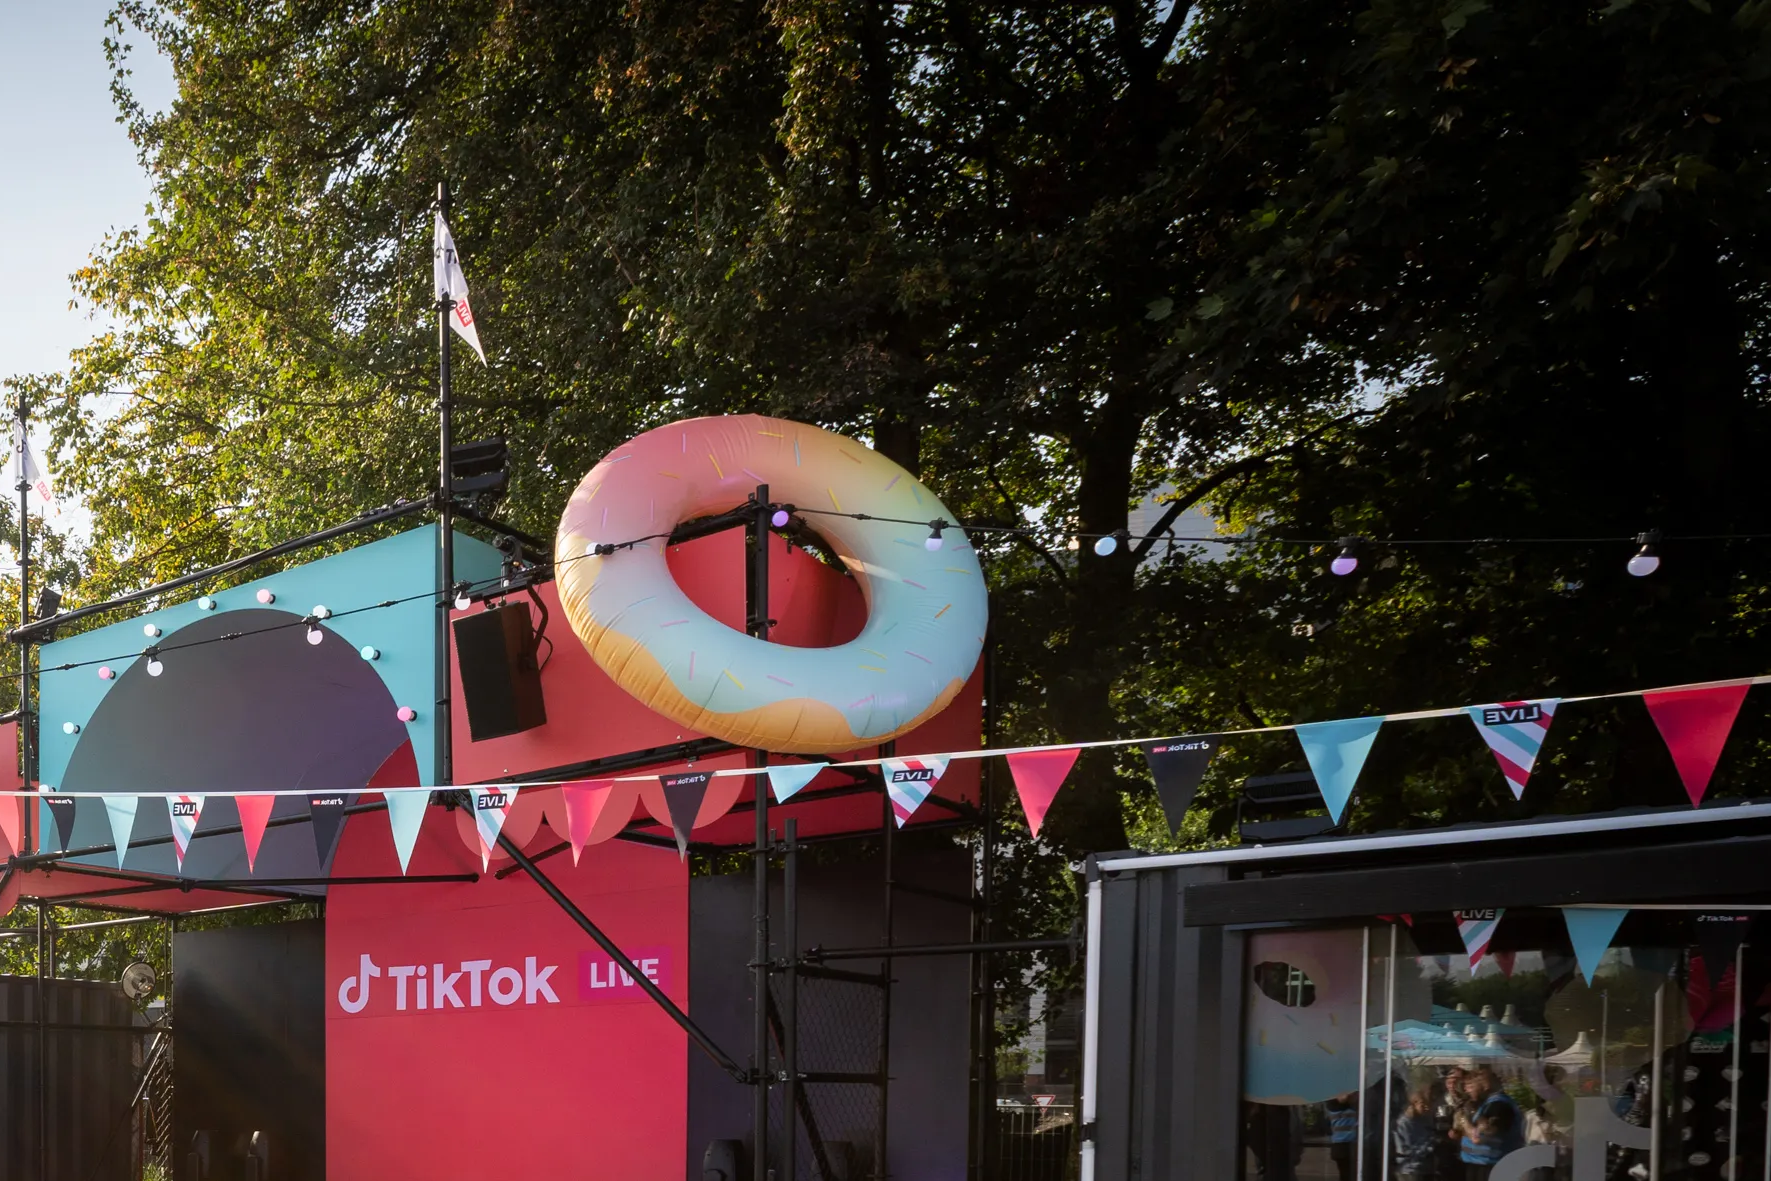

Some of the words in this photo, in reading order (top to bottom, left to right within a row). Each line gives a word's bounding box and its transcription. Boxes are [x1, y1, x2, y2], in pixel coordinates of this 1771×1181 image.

[1462, 909, 1495, 919] LIVE
[1707, 914, 1734, 922] TikTok
[388, 956, 561, 1012] TikTok
[590, 958, 659, 989] LIVE
